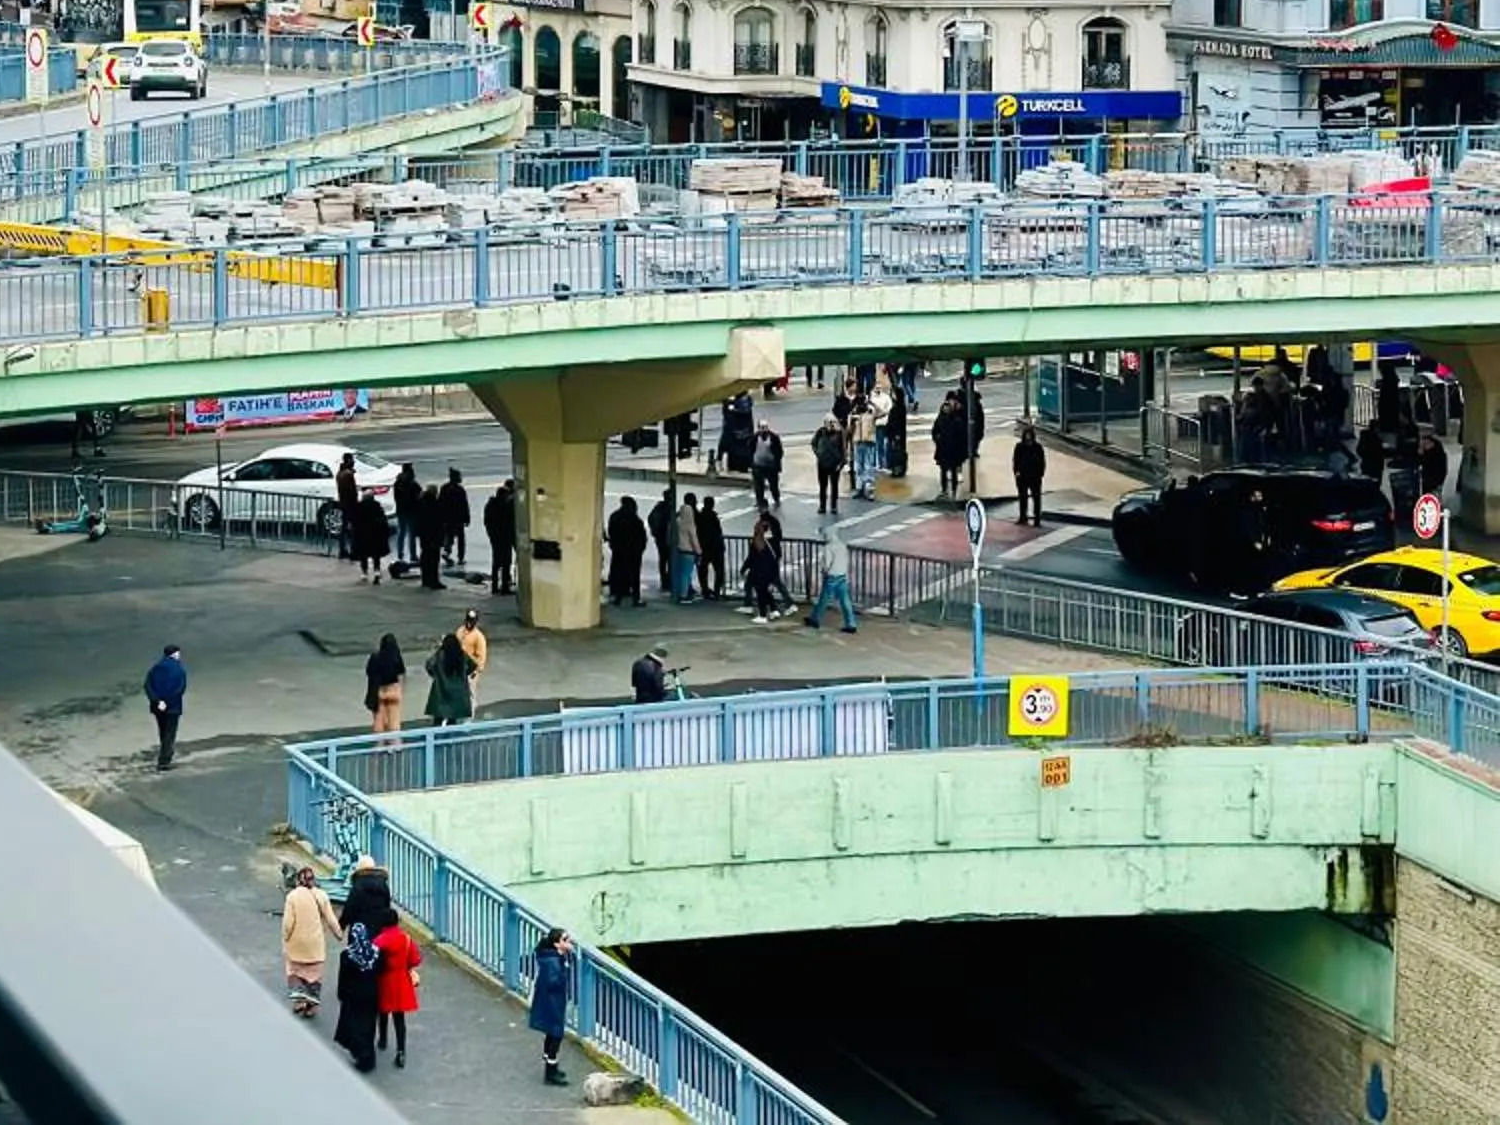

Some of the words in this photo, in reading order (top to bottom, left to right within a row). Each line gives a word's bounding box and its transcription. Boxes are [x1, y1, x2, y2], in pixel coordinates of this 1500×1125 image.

[1241, 44, 1273, 60] HOTEL
[1021, 98, 1087, 112] TURKCELL
[1025, 694, 1037, 714] 3
